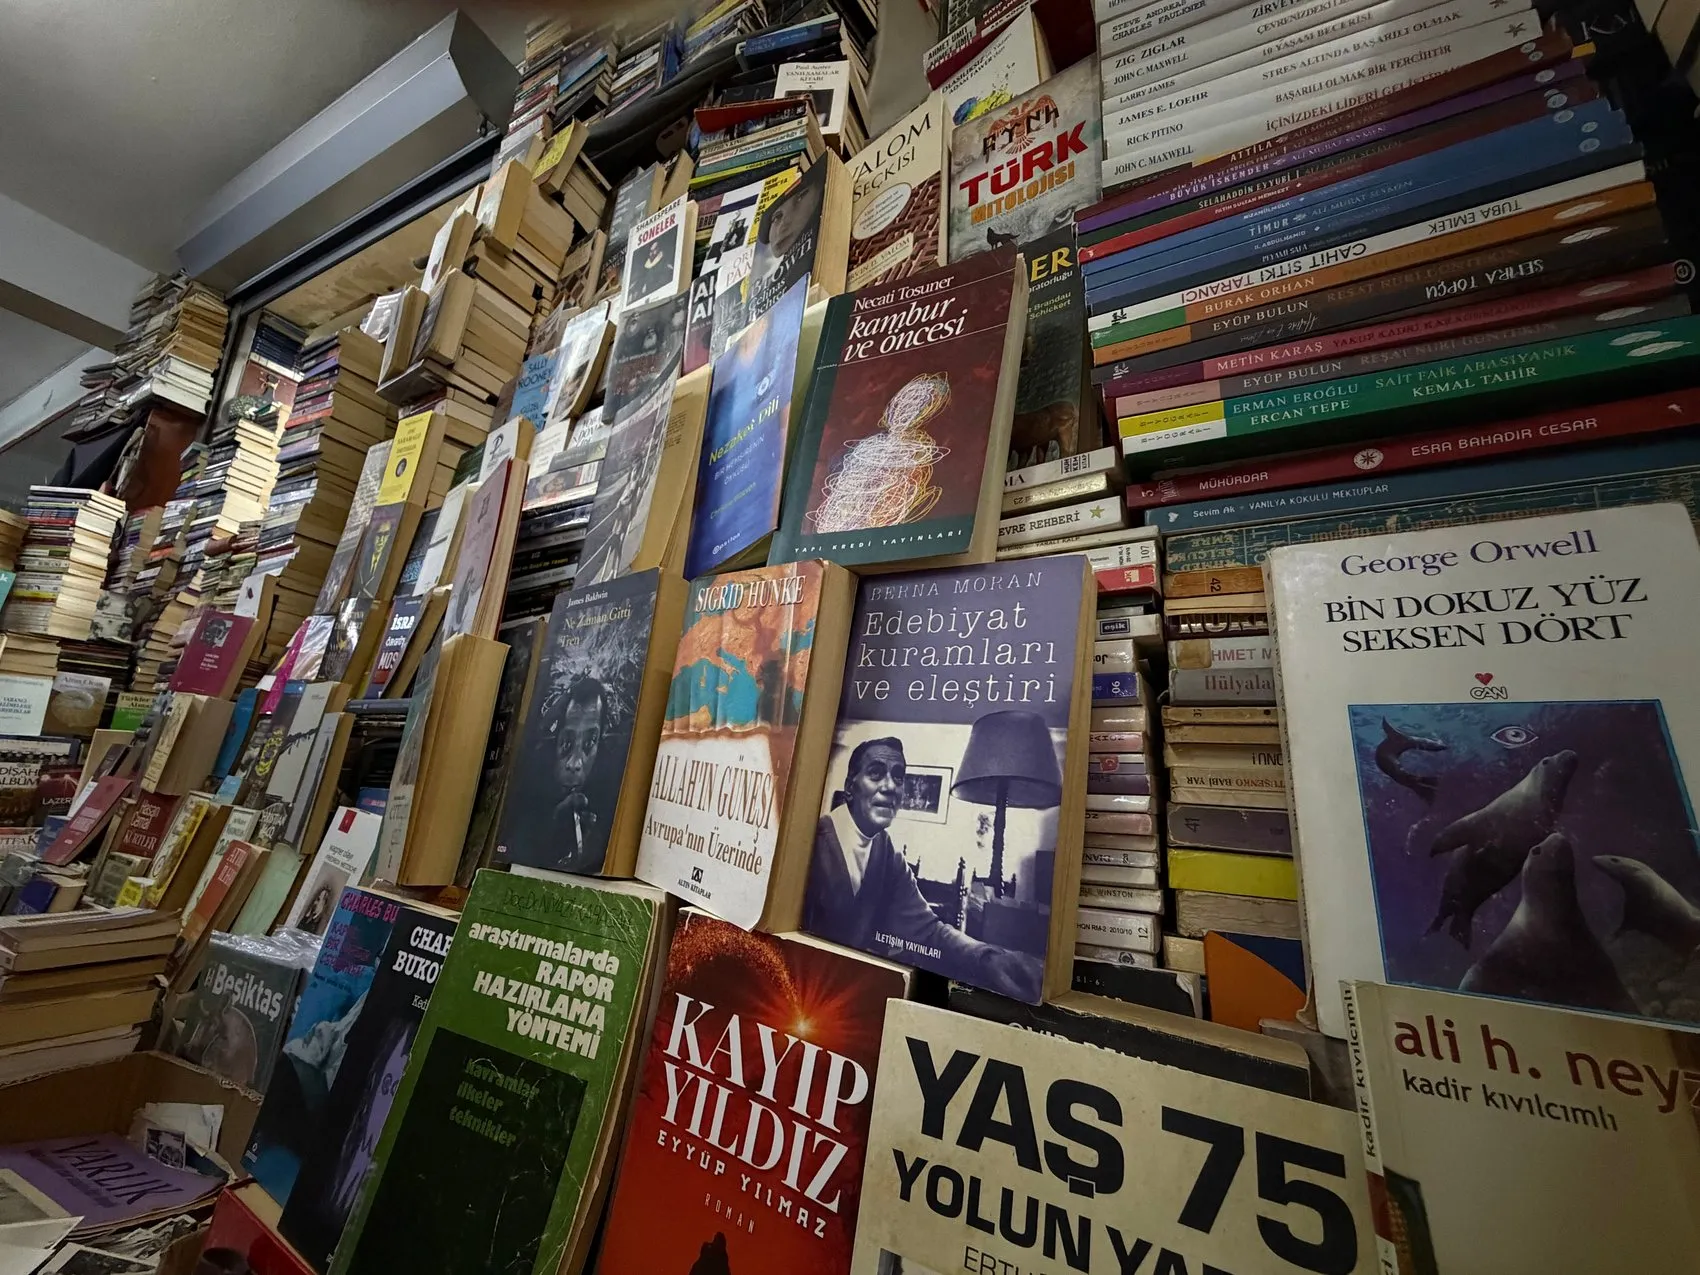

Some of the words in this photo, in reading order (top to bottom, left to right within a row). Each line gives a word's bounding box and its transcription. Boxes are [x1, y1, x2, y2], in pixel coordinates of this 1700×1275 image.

[1112, 21, 1152, 41] CHARLES
[1158, 1, 1206, 24] FAULKNER
[1112, 16, 1140, 33] STEVE
[1115, 53, 1136, 69] ZIG
[1141, 36, 1186, 58] ZIGLAR
[1262, 63, 1297, 81] STRES
[1299, 47, 1349, 70] ALTINDA
[1352, 27, 1409, 52] BAŞARILI
[1412, 12, 1462, 33] OLMAK
[1113, 69, 1135, 86] JOHN
[1136, 66, 1145, 79] C.
[1146, 52, 1188, 75] MAXWELL
[1275, 81, 1324, 104] BAŞARILI
[1325, 68, 1366, 88] OLMAK
[1368, 61, 1387, 77] BİR
[1390, 43, 1452, 72] TERCİHTİR
[1118, 107, 1153, 126] JAMES
[1155, 105, 1167, 116] E.
[1169, 90, 1209, 112] LOEHR
[1120, 88, 1146, 104] LARRY
[1147, 79, 1176, 95] JAMES
[1266, 103, 1333, 132] İÇİNİZDEKİ
[1336, 87, 1379, 110] LİDERİ
[1127, 132, 1149, 147] RICK
[1151, 122, 1184, 140] PITINO
[1230, 139, 1272, 162] ATTİLA
[959, 119, 1089, 208] TÜRK
[1114, 159, 1138, 176] JOHN
[1138, 158, 1149, 169] C.
[1149, 145, 1194, 166] MAXWELL
[1170, 184, 1207, 200] BÜYÜK
[1211, 162, 1270, 187] İSKENDER
[1199, 185, 1253, 209] SELAHADDİN
[1257, 171, 1290, 191] EYYUBİ
[635, 198, 681, 233] SHAKESPEARE
[1250, 218, 1289, 236] TİMUR
[1428, 212, 1476, 235] EMLEK
[1481, 199, 1522, 220] TUBA
[637, 213, 676, 246] SONELER
[1030, 247, 1074, 282] ER
[1309, 243, 1367, 269] CAHİT
[853, 292, 896, 313] Necati
[897, 275, 955, 299] Tosuner
[1181, 275, 1254, 304] TARANCI
[1204, 294, 1254, 314] BURAK
[1260, 277, 1315, 298] ORHAN
[1425, 275, 1477, 299] TOPÇU
[849, 295, 957, 341] kambur
[1213, 313, 1251, 332] EYÜP
[1257, 300, 1309, 322] BULUN
[843, 339, 875, 363] ve
[879, 308, 969, 354] öncesi
[1217, 353, 1265, 371] METİN
[1270, 341, 1323, 364] KARAŞ
[1233, 396, 1287, 414] ERMAN
[1293, 381, 1358, 403] EROĞLU
[1376, 371, 1412, 389] SAİT
[1243, 366, 1286, 388] EYÜP
[1288, 361, 1342, 382] BULUN
[1250, 408, 1303, 426] ERCAN
[1309, 399, 1350, 415] TEPE
[1413, 377, 1475, 397] KEMAL
[1480, 366, 1538, 385] TAHİR
[708, 415, 758, 467] Nezaket
[758, 395, 781, 425] Dili
[1199, 471, 1269, 490] MÜHÜRDAR
[1412, 441, 1452, 457] ESRA
[1458, 427, 1533, 449] BAHADIR
[1539, 417, 1598, 436] CESAR
[1193, 508, 1220, 518] Sevim
[1223, 505, 1235, 514] Ak
[1289, 492, 1329, 505] KOKULU
[1333, 484, 1389, 499] MEKTUPLAR
[1029, 511, 1081, 531] REHBERİ
[794, 545, 823, 555] YAPI
[832, 540, 872, 551] KREDİ
[882, 529, 964, 547] YAYINLARI
[1140, 545, 1150, 559] 107
[1340, 549, 1458, 577] George
[1470, 529, 1598, 564] Orwell
[567, 597, 584, 609] James
[585, 590, 608, 604] Baldwin
[695, 583, 745, 613] SIGRID
[746, 575, 806, 610] HUNKE
[870, 582, 941, 601] BERNA
[953, 571, 1043, 595] MORAN
[1210, 577, 1222, 593] 42
[1324, 595, 1385, 623] BİN
[1394, 586, 1539, 619] DOKUZ
[1548, 574, 1648, 606] YÜZ
[577, 611, 608, 629] Zaman
[608, 605, 632, 622] Gitti
[862, 601, 1027, 639] Edebiyat
[1342, 622, 1485, 653] SEKSEN
[1500, 613, 1632, 646] DÖRT
[560, 635, 580, 648] Tren
[857, 638, 1058, 669] kuramları
[854, 679, 891, 701] ve
[907, 673, 1057, 709] eleştiri
[1470, 687, 1508, 700] CAN
[652, 754, 718, 813] ALLAH'IN
[1187, 776, 1206, 785] YAR
[1209, 777, 1232, 787] BABİ
[644, 813, 705, 854] Avrupa'nın
[707, 825, 764, 876] Üzerinde
[678, 877, 693, 892] ALTIN
[341, 892, 384, 919] CHARLES
[468, 920, 620, 976] araştırmalarda
[875, 931, 905, 948] İLETİŞİM
[905, 940, 942, 960] YAYINLARI
[1138, 927, 1148, 940] 12
[211, 963, 284, 1022] Beşiktaş
[535, 960, 615, 1003] RAPOR
[473, 971, 606, 1032] HAZIRLAMA
[506, 1007, 600, 1060] YÖNTEMİ
[1394, 1015, 1461, 1064] ali
[1480, 1024, 1541, 1080] h.
[663, 993, 869, 1132] KAYIP
[456, 1081, 504, 1113] ilkeler
[1402, 1068, 1473, 1102] kadir
[1482, 1084, 1618, 1132] kıvılcımlı
[449, 1105, 517, 1148] teknikler
[660, 1060, 849, 1213] YILDIZ
[904, 1036, 1125, 1199] YAŞ
[1161, 1106, 1358, 1275] 75
[657, 1129, 727, 1176] EYYÜP
[740, 1173, 827, 1239] YILMAZ
[704, 1193, 756, 1235] ROMAN
[891, 1148, 1092, 1273] YOLUN
